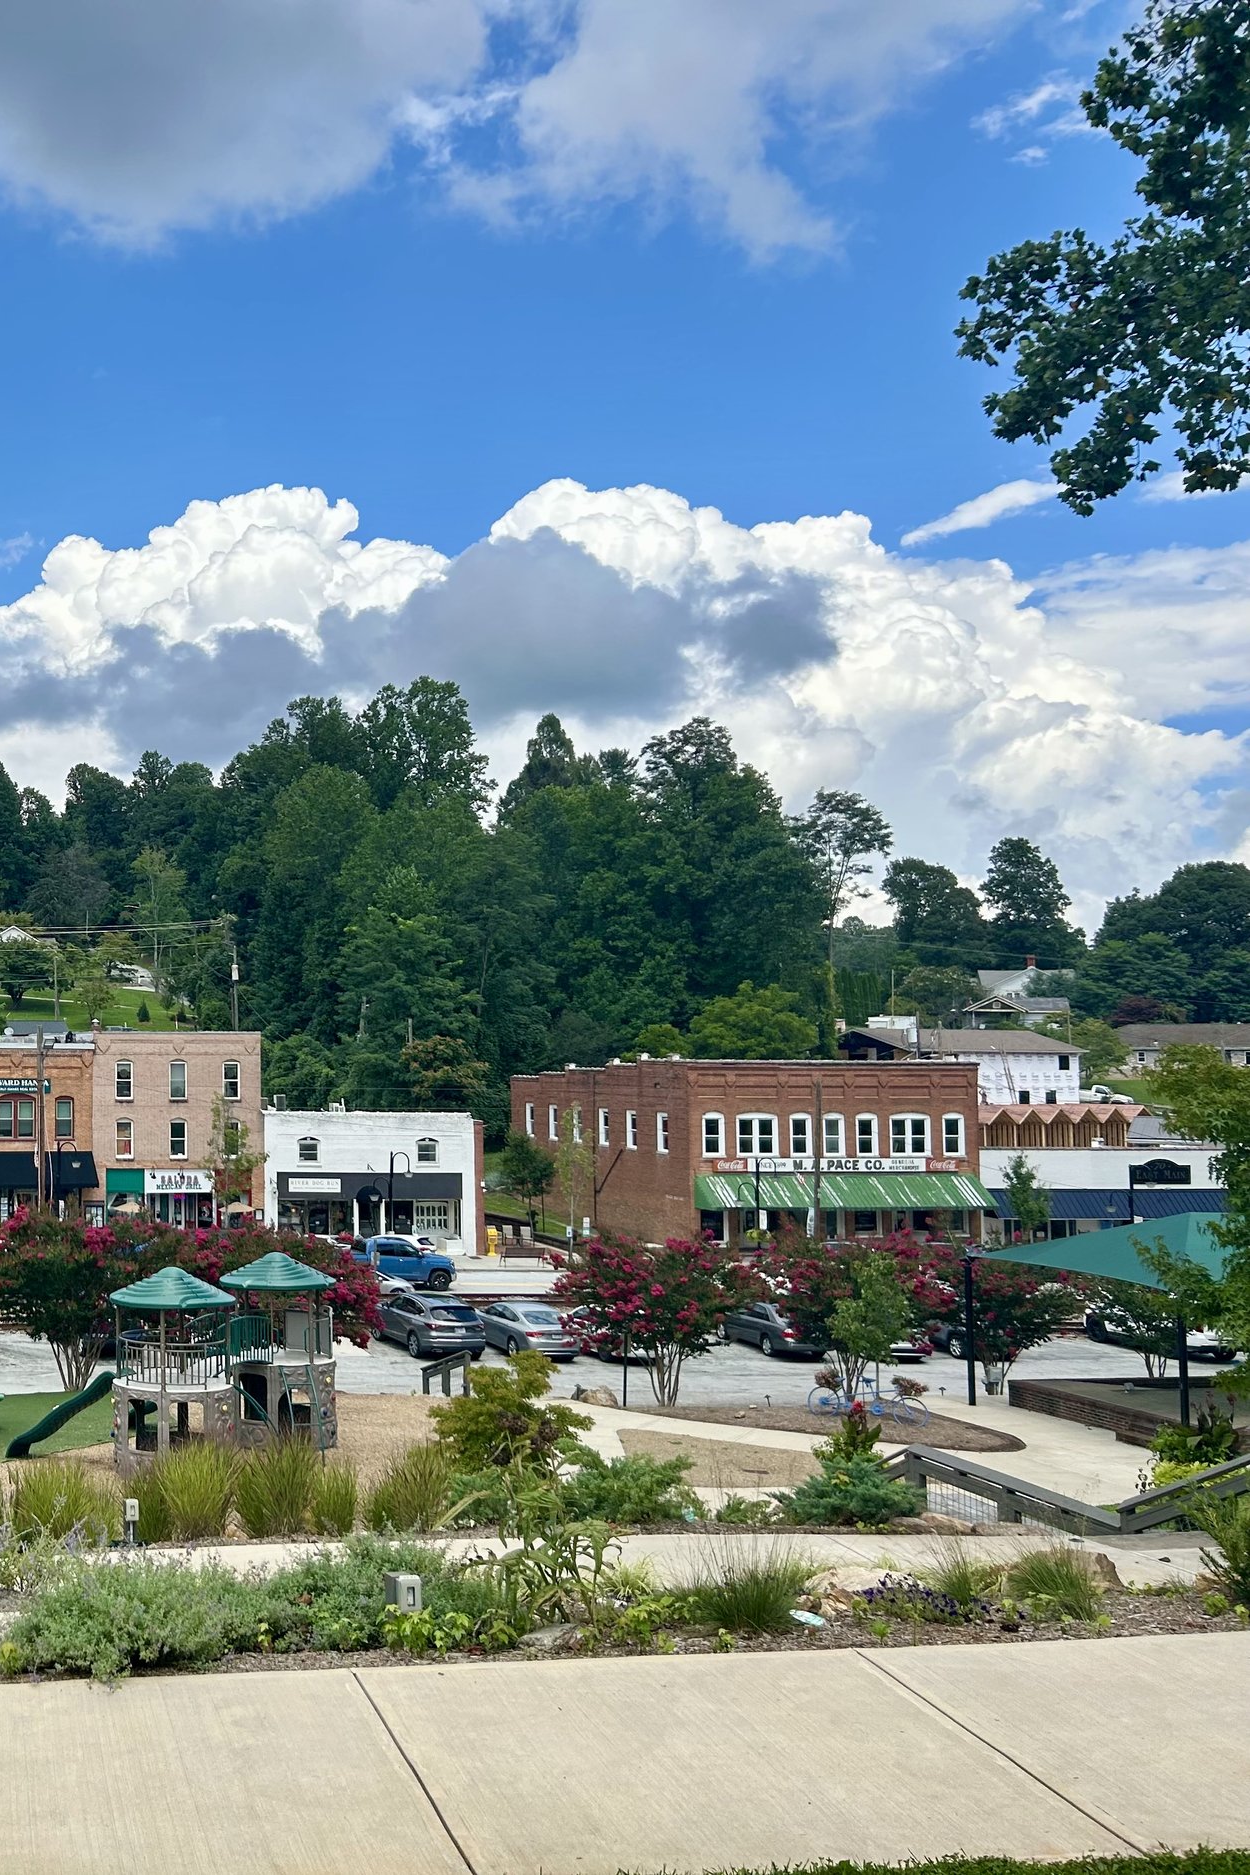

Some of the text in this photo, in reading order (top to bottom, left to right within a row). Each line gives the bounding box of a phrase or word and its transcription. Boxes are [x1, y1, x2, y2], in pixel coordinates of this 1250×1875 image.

[827, 1160, 860, 1170] PACE
[865, 1160, 885, 1170] CO.
[160, 1175, 199, 1186] SALUDA
